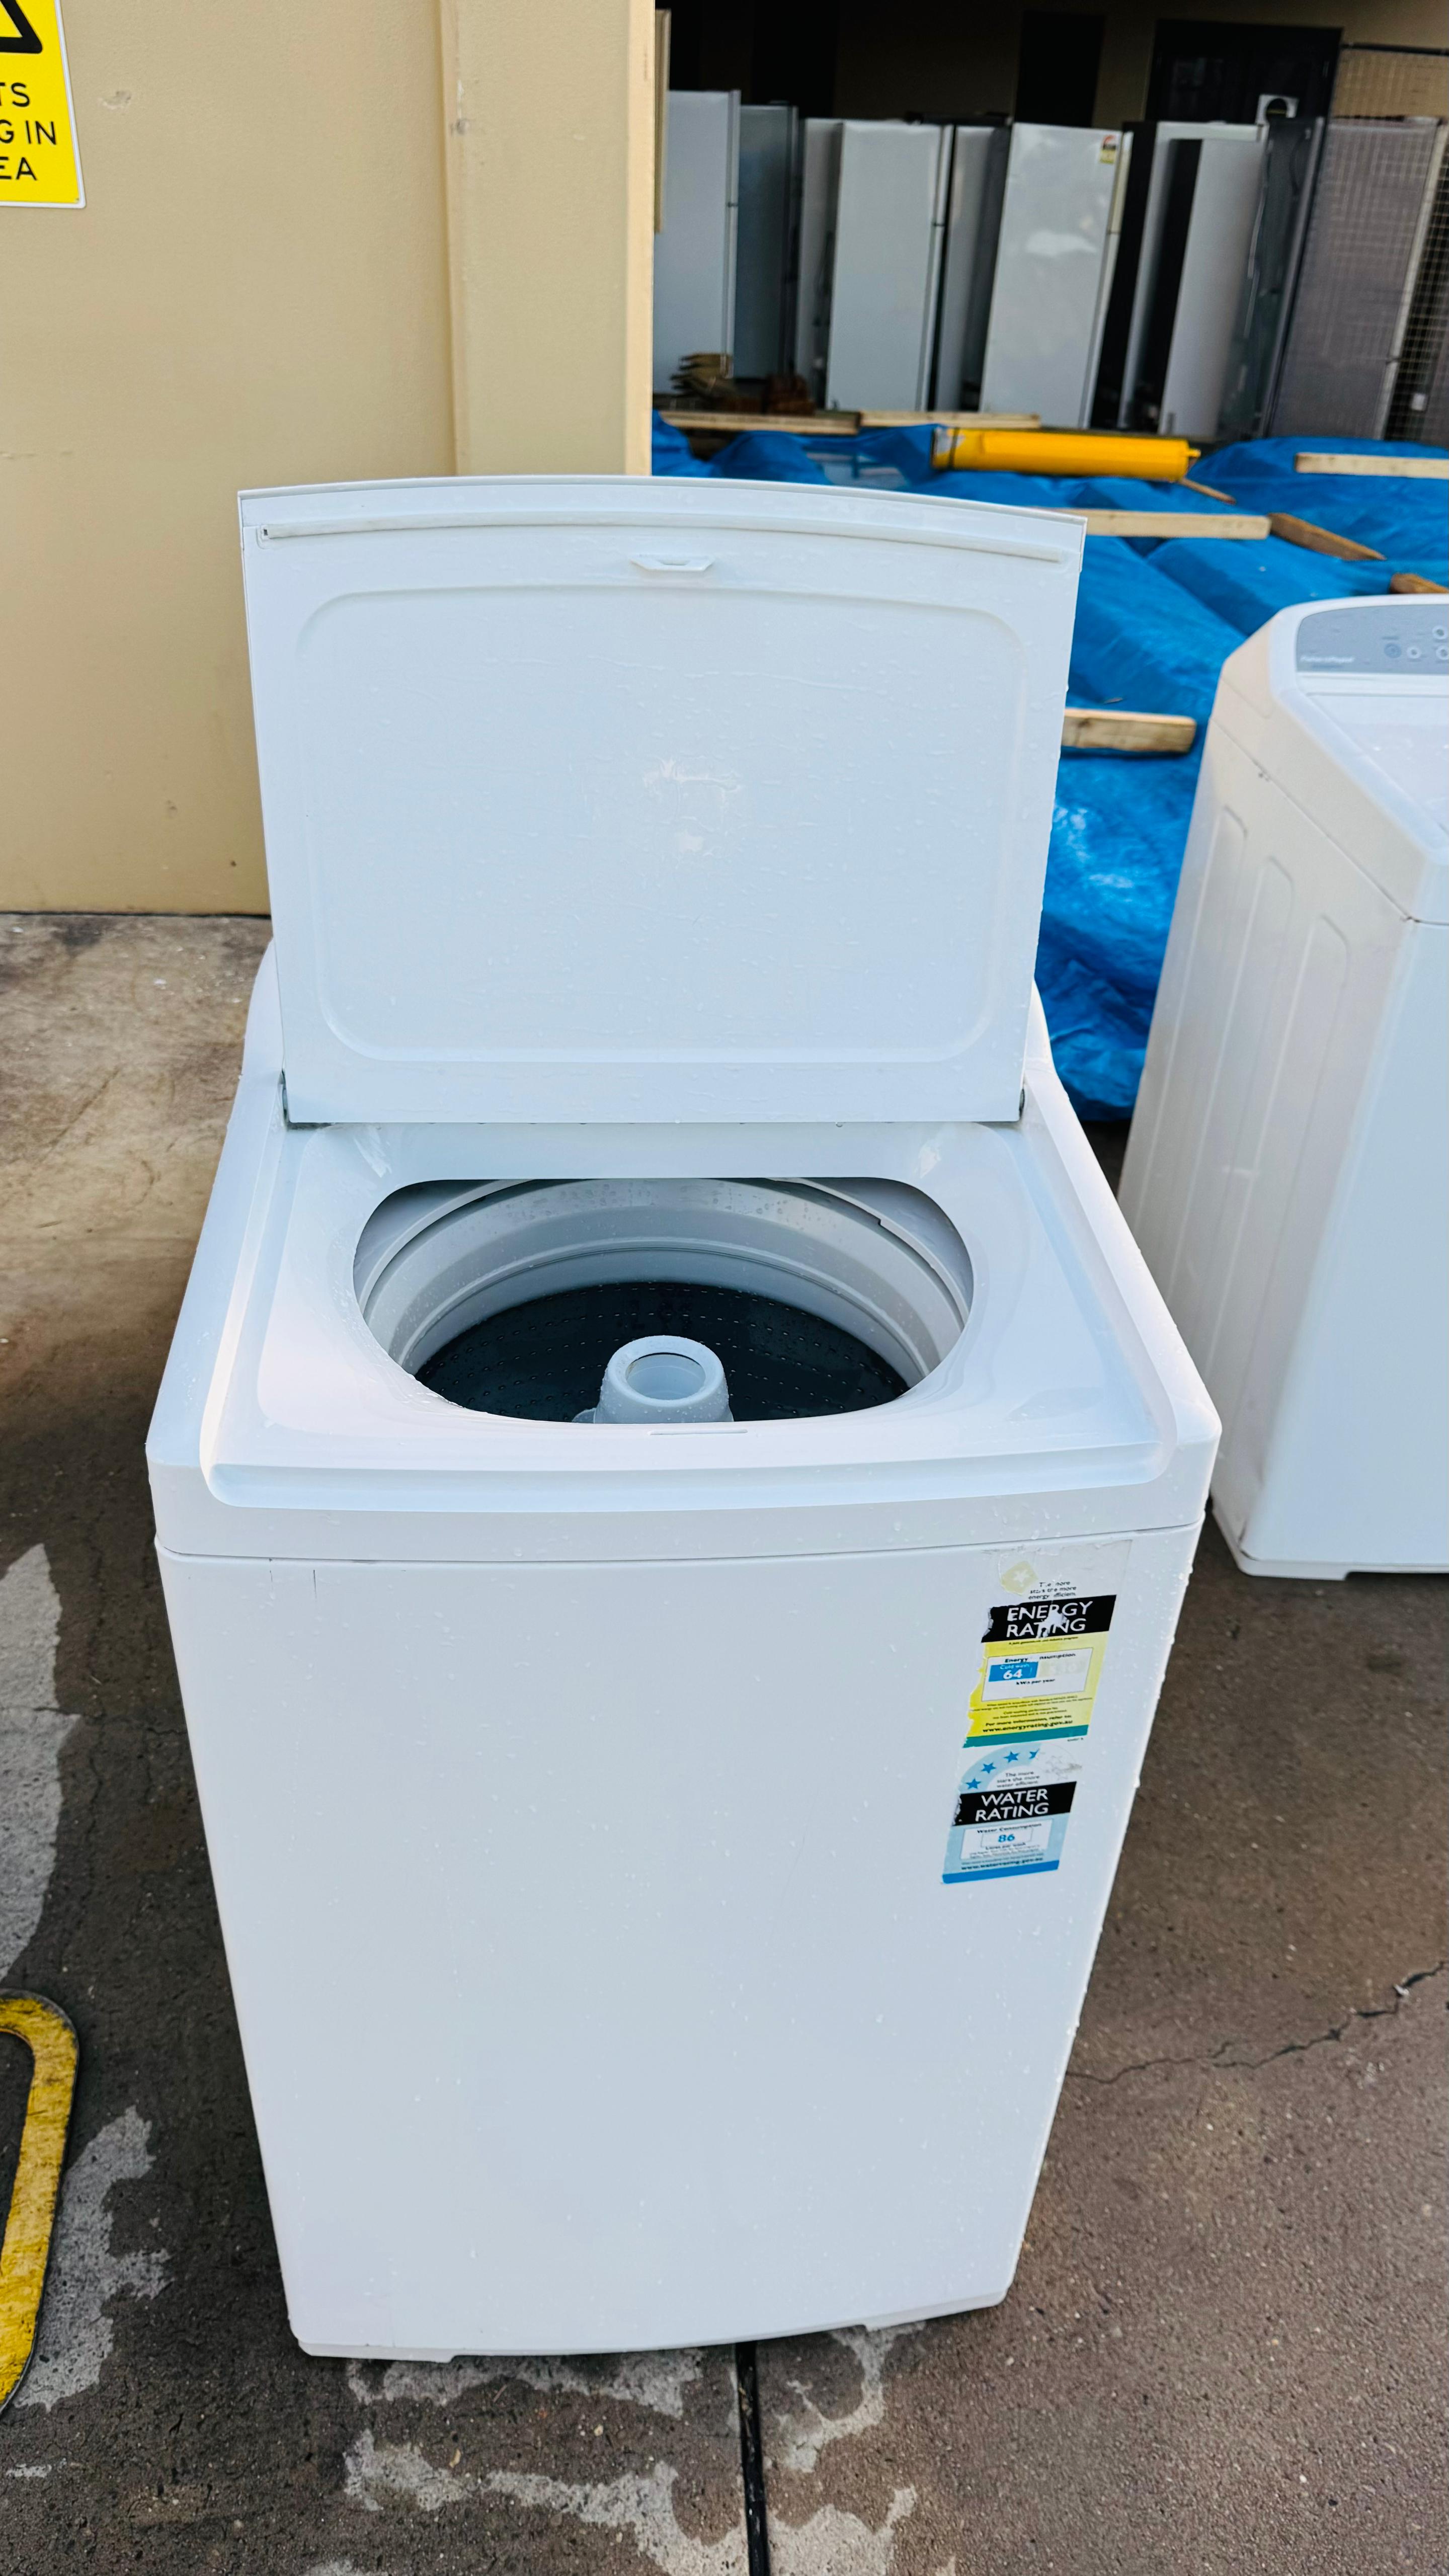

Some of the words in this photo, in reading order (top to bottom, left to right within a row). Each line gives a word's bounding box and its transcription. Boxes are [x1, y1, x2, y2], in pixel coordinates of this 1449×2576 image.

[25, 120, 56, 145] IN
[1007, 1601, 1093, 1622] ENERGY
[1006, 1618, 1087, 1638] RATING
[1003, 1668, 1023, 1680] 64
[981, 1788, 1049, 1807] WATER
[975, 1802, 1050, 1822] RATING
[998, 1833, 1015, 1842] 86
